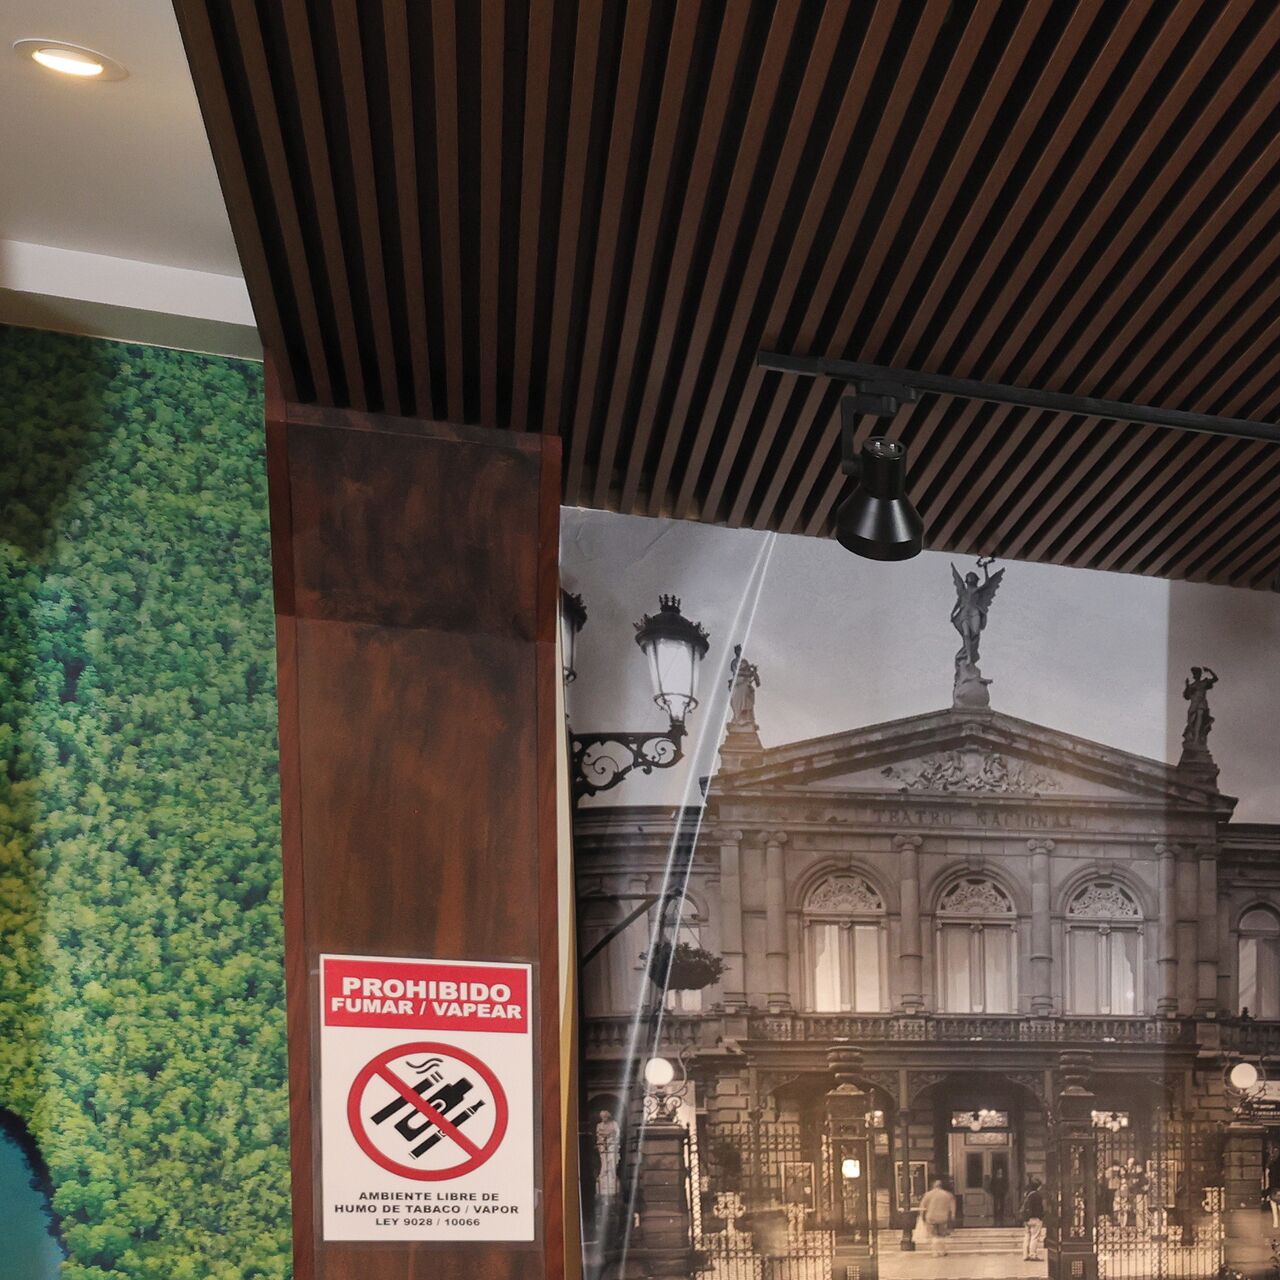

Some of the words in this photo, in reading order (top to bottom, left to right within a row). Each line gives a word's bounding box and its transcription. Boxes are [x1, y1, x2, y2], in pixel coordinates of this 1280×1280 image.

[873, 808, 953, 825] TEATRO
[976, 810, 1072, 828] NACIONAL
[342, 976, 512, 1003] PROHIBIDO
[331, 997, 414, 1016] FUMAR
[418, 1001, 426, 1017] /
[433, 1001, 523, 1020] VAPEAR
[358, 1191, 433, 1202] AMBIENTE
[436, 1192, 478, 1202] LIBRE
[481, 1192, 500, 1202] DE
[334, 1204, 378, 1214] HUMO
[382, 1204, 401, 1214] DE
[404, 1204, 461, 1214] TABACO
[473, 1204, 520, 1215] VAPOR
[375, 1217, 400, 1226] LEY
[403, 1217, 434, 1227] 9028
[444, 1217, 481, 1227] 10066
